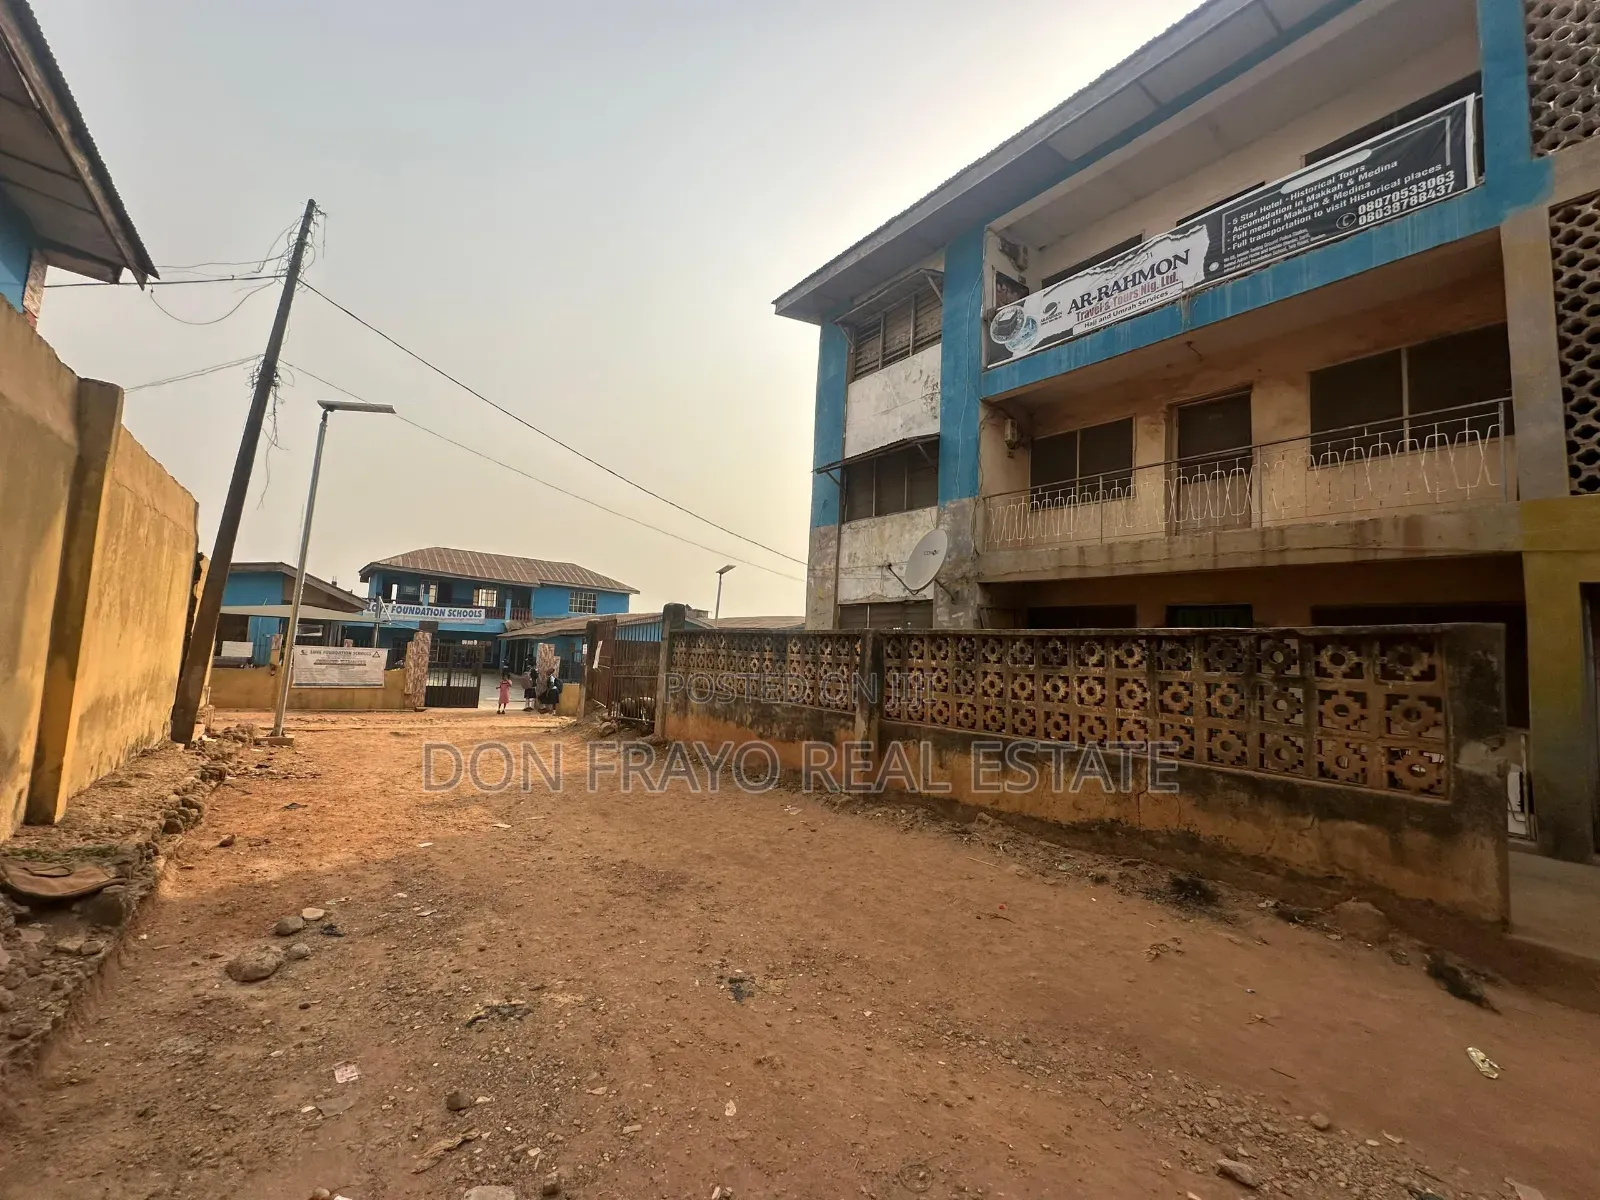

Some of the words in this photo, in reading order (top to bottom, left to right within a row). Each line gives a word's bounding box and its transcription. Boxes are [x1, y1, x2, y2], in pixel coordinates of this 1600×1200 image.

[1232, 204, 1292, 233] Accomodation
[1294, 199, 1303, 207] in
[1306, 183, 1343, 203] Makkah
[1347, 178, 1354, 186] &
[1358, 160, 1398, 181] Medina
[1232, 240, 1247, 250] Full
[1249, 215, 1311, 243] transportation
[1326, 200, 1347, 213] visit
[1350, 178, 1401, 203] Historical
[1404, 164, 1442, 184] places
[1232, 231, 1246, 242] Full
[1249, 220, 1270, 236] meal
[1272, 217, 1280, 225] in
[1283, 202, 1319, 221] Makkah
[1322, 197, 1329, 205] &
[1333, 181, 1371, 201] Medina
[1240, 210, 1258, 222] Star
[1260, 199, 1282, 214] Hotel
[1290, 177, 1335, 201] Historical
[1337, 165, 1366, 180] Tours
[1358, 170, 1455, 215] 08070533063
[1358, 181, 1455, 226] 08038788437
[1067, 248, 1190, 315] AR-RAHMON
[1076, 303, 1104, 322] Travel
[1112, 288, 1139, 308] Tours
[1140, 281, 1159, 295] Nig.
[1161, 272, 1178, 287] Ltd.
[1084, 319, 1097, 328] Hajj
[1098, 312, 1112, 323] and
[1112, 303, 1137, 316] Umrah
[1138, 290, 1168, 307] Services
[391, 605, 446, 617] FOUNDATION
[447, 610, 482, 618] SCHOOLS
